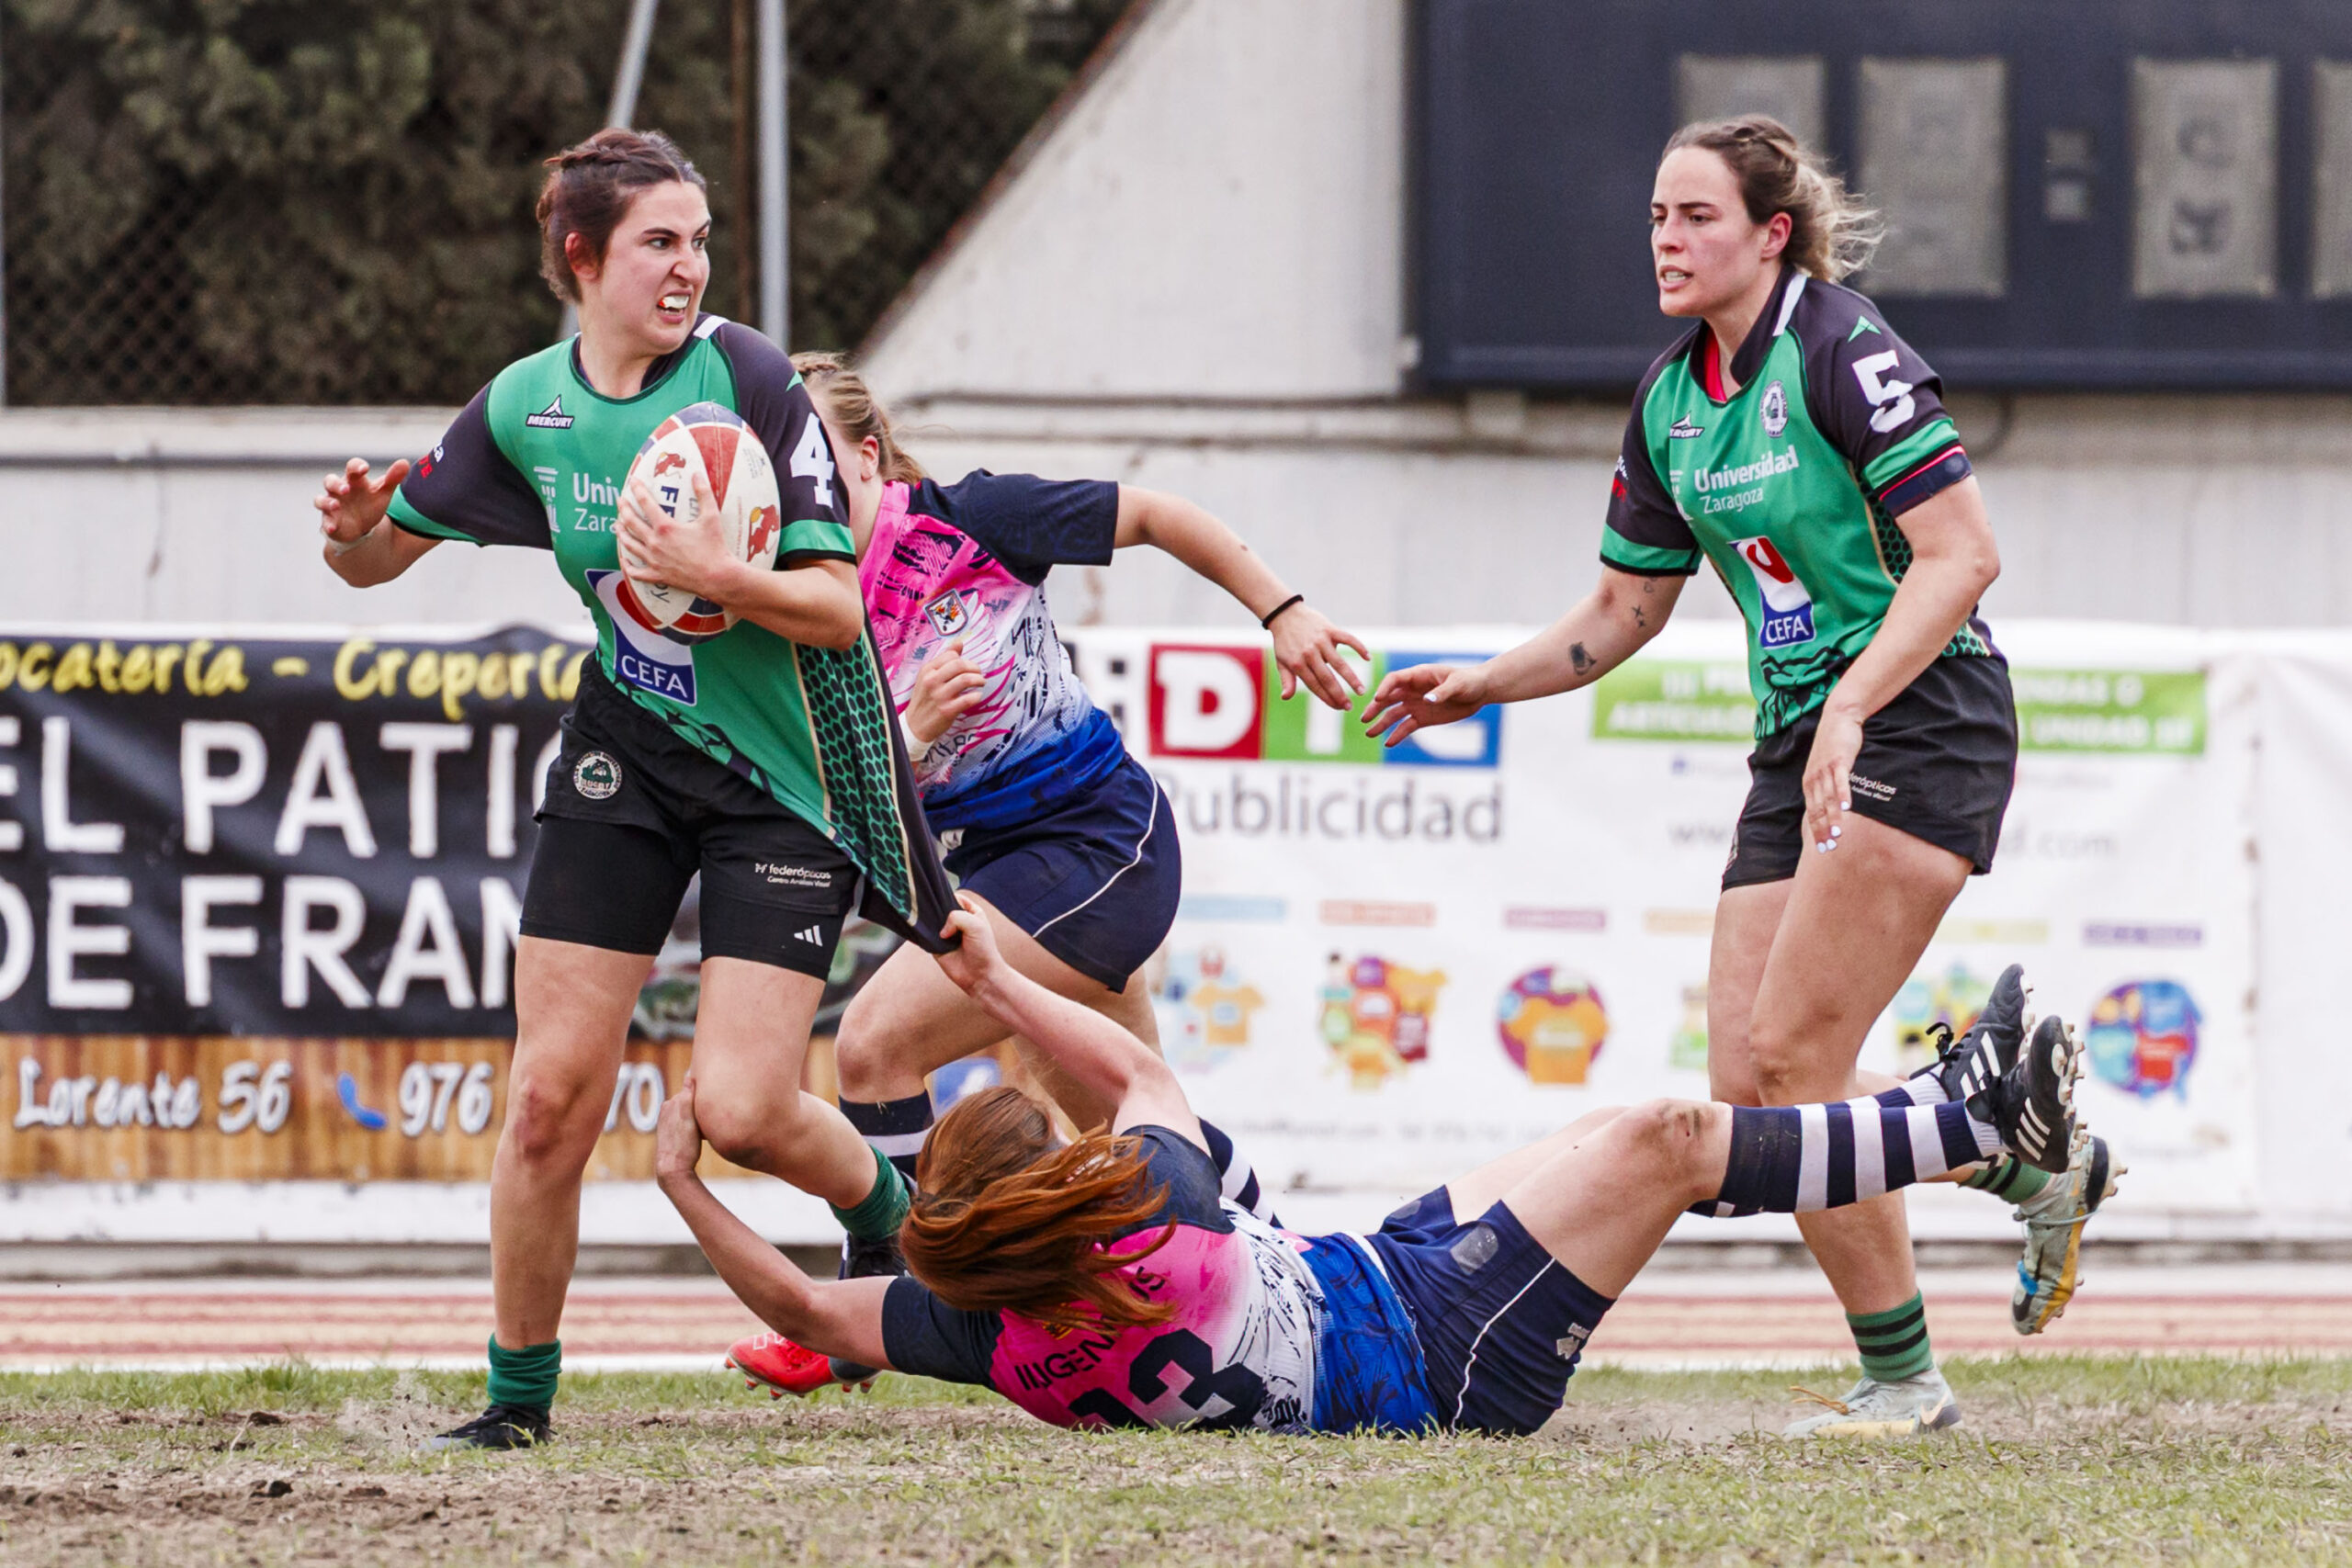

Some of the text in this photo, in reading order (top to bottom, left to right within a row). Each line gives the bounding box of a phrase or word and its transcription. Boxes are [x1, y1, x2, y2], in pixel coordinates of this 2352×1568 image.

[1851, 349, 1916, 434] 5
[526, 415, 574, 428] MERCURY
[1669, 427, 1704, 438] ERCURY
[789, 412, 835, 509] 4
[1694, 445, 1800, 493] Universidad
[1700, 488, 1764, 514] Zaragoza
[1766, 615, 1809, 643] CEFA
[621, 654, 688, 698] CEFA
[0, 716, 125, 853] L
[14, 1055, 202, 1129] Lorente
[217, 1060, 292, 1134] 56
[399, 1061, 494, 1137] 976
